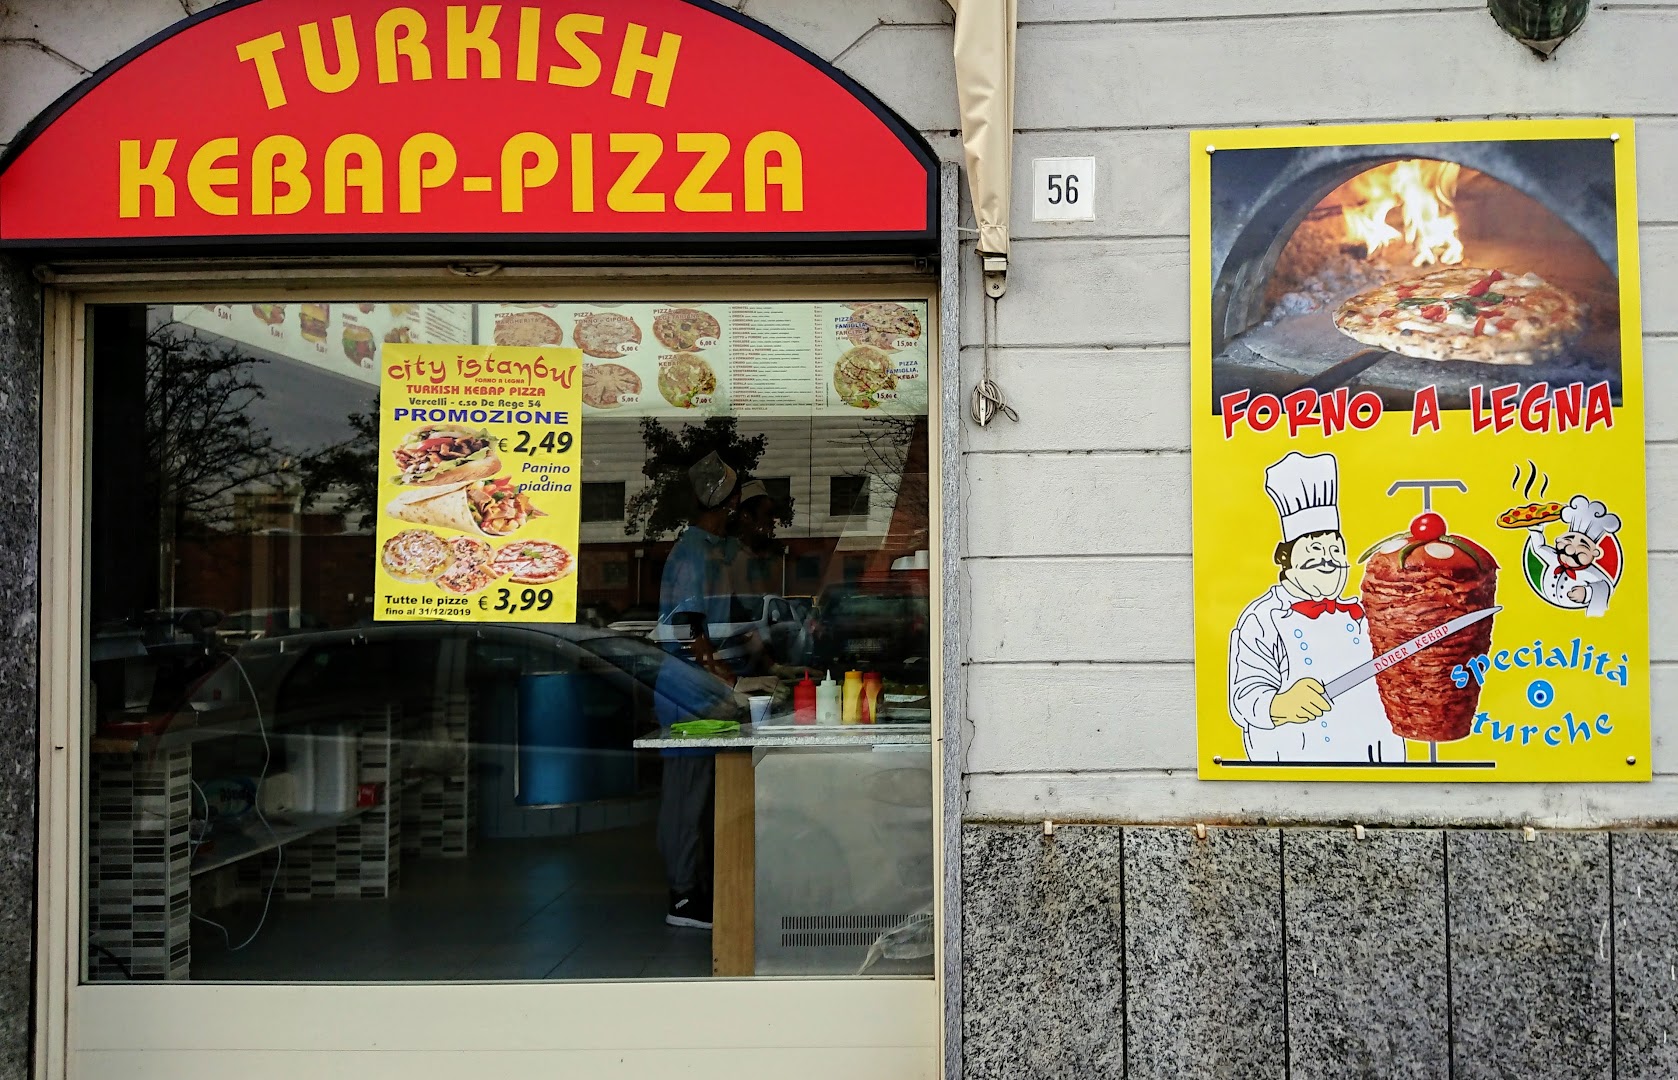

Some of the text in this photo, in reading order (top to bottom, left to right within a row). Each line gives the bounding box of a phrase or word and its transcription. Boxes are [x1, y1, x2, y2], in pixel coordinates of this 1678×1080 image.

[235, 5, 683, 110] TURKISH
[119, 130, 804, 218] KEBAP-PIZZA
[1048, 174, 1079, 205] 56
[388, 352, 576, 390] city istanbul
[406, 384, 546, 397] TURKISH KEBAP PIZZA
[408, 397, 447, 406] Vercelli
[480, 398, 495, 408] De
[498, 398, 524, 410] Rege
[527, 399, 542, 408] 54
[1221, 382, 1614, 441] FORNO A LEGNA
[394, 408, 569, 425] PROMOZIONE
[498, 430, 573, 456] € 2,49
[522, 462, 571, 474] Panino
[540, 474, 549, 482] o
[518, 481, 572, 494] piadina
[384, 596, 469, 607] Tutte le pizze
[418, 608, 471, 616] 31/12/2019
[478, 588, 554, 614] € 3,99
[1414, 625, 1449, 649] KEBAP
[1450, 637, 1628, 690] specialità
[1472, 712, 1615, 747] turche
